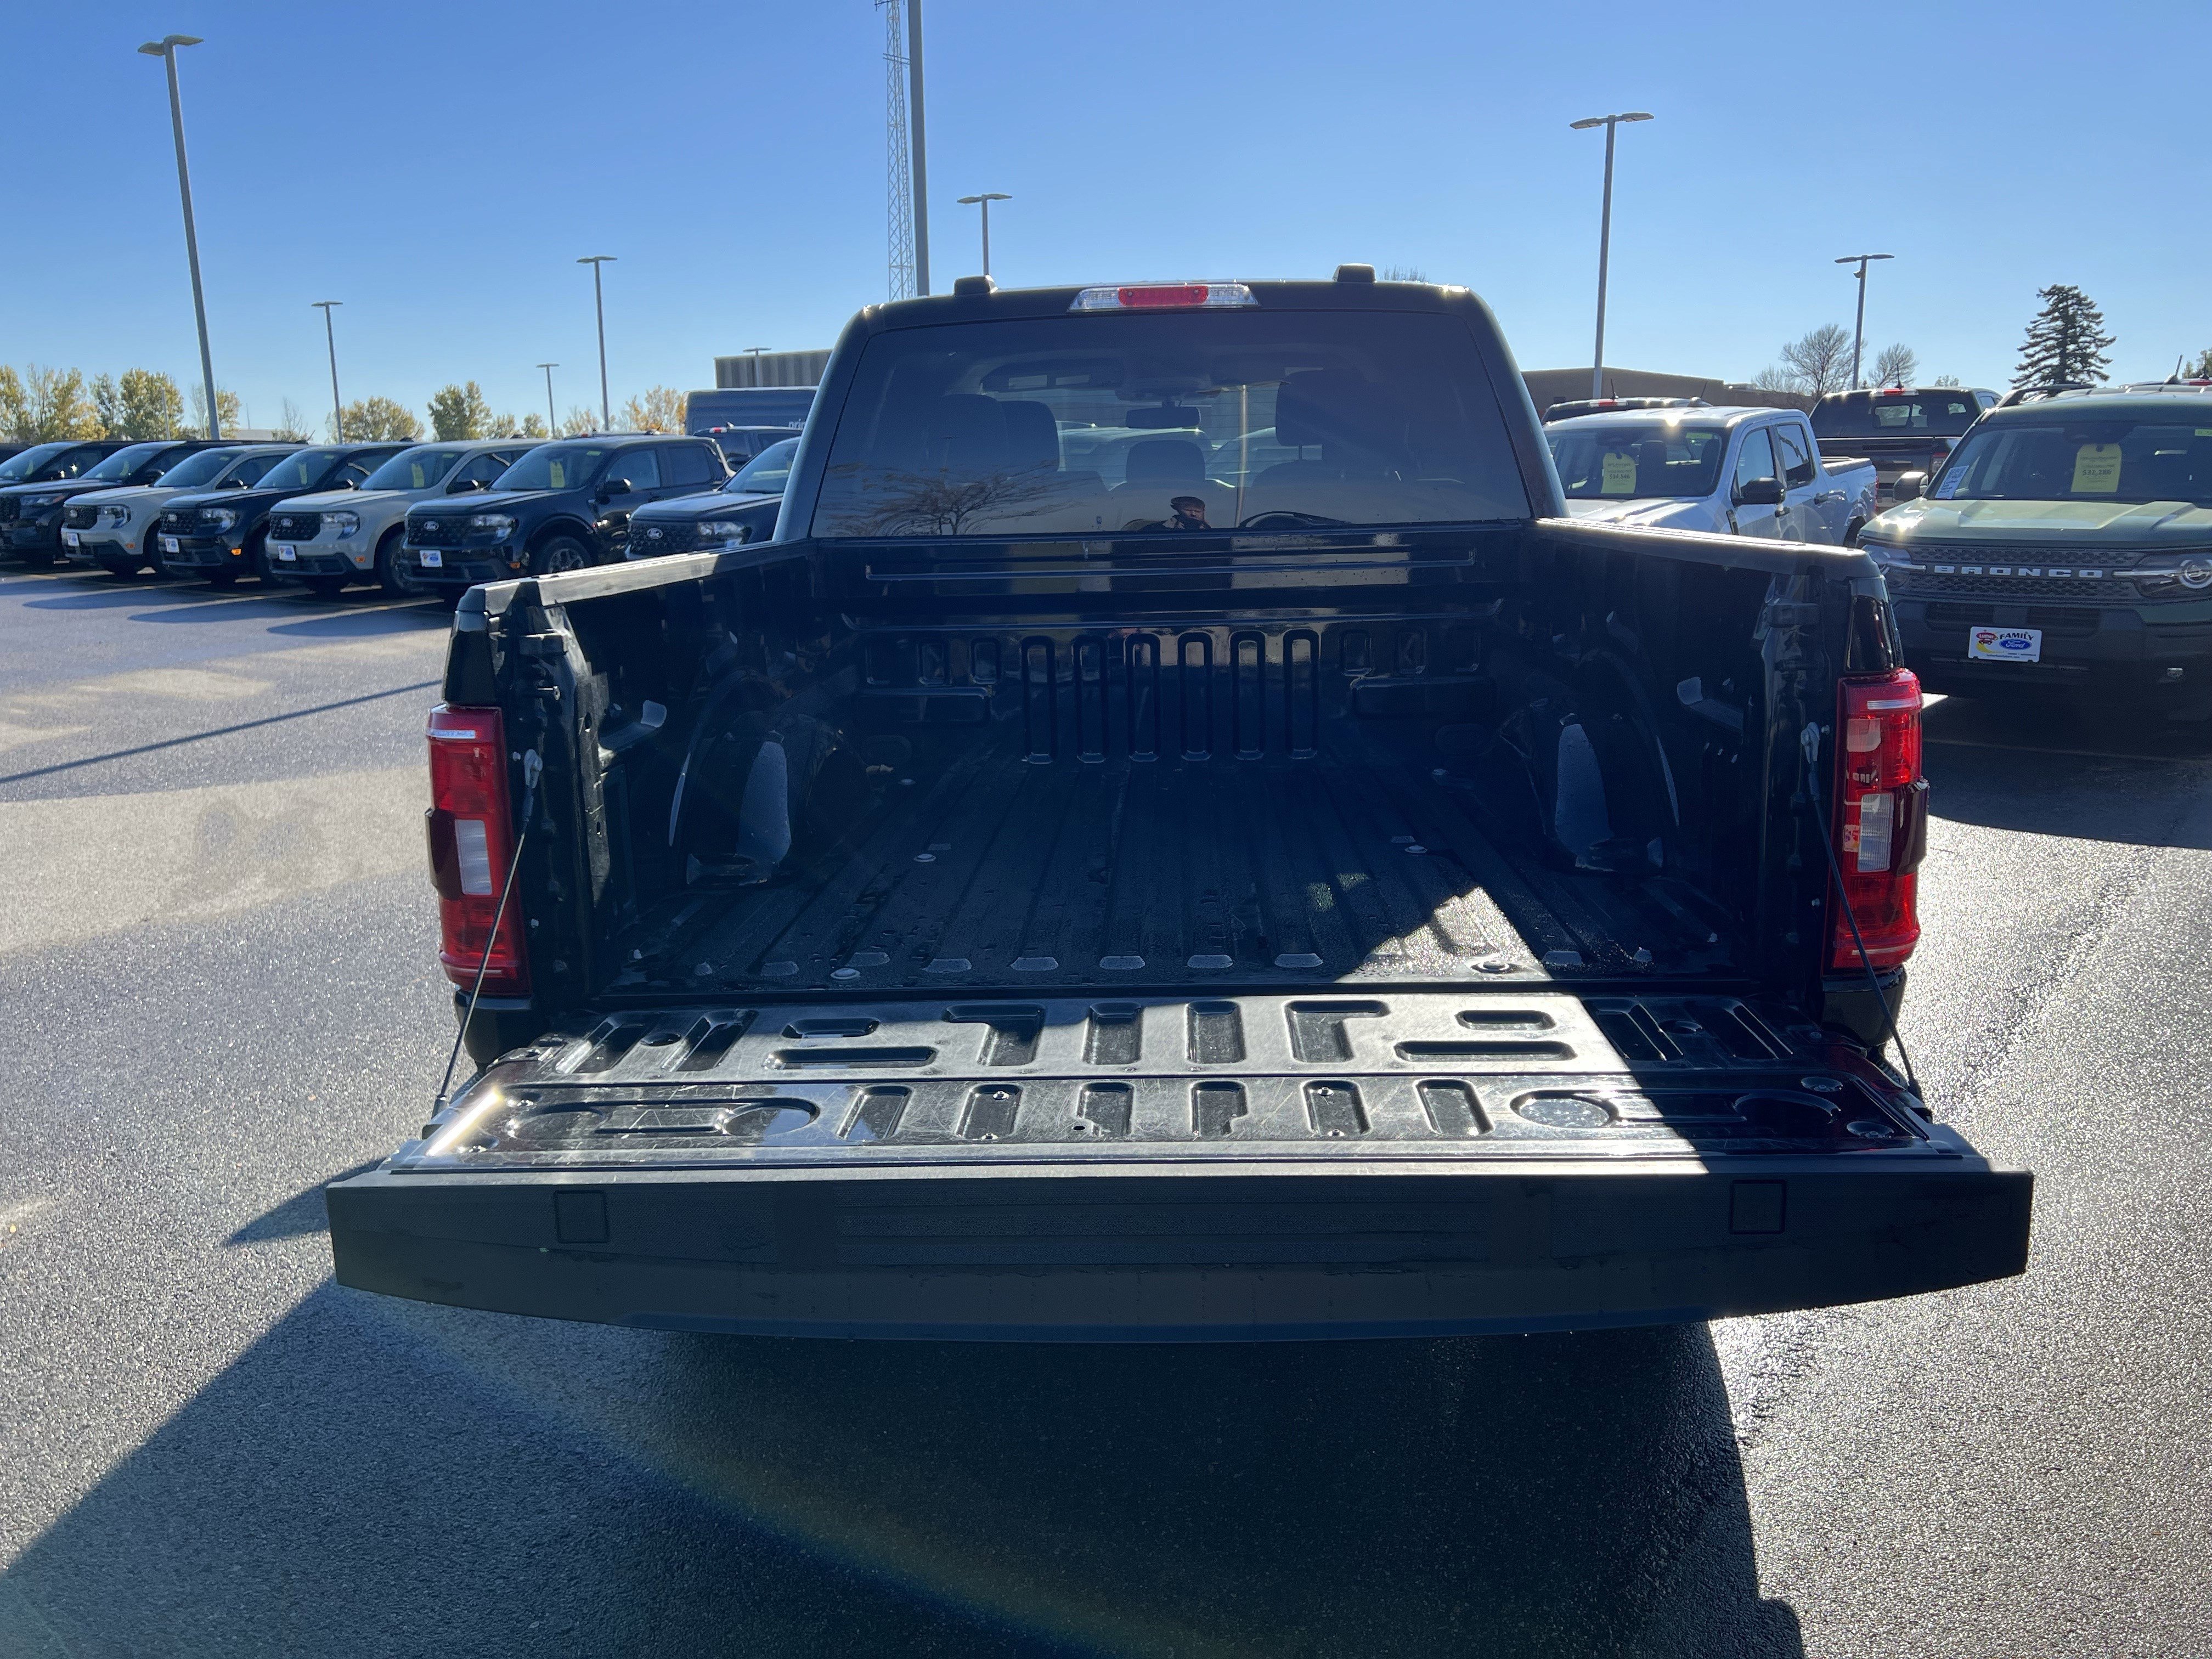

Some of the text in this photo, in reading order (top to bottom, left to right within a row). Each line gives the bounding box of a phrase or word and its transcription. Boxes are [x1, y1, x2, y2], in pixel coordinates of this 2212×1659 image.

[1934, 565, 2103, 578] BRONCO
[2000, 633, 2034, 641] FAMILY
[2005, 640, 2025, 648] Ford
